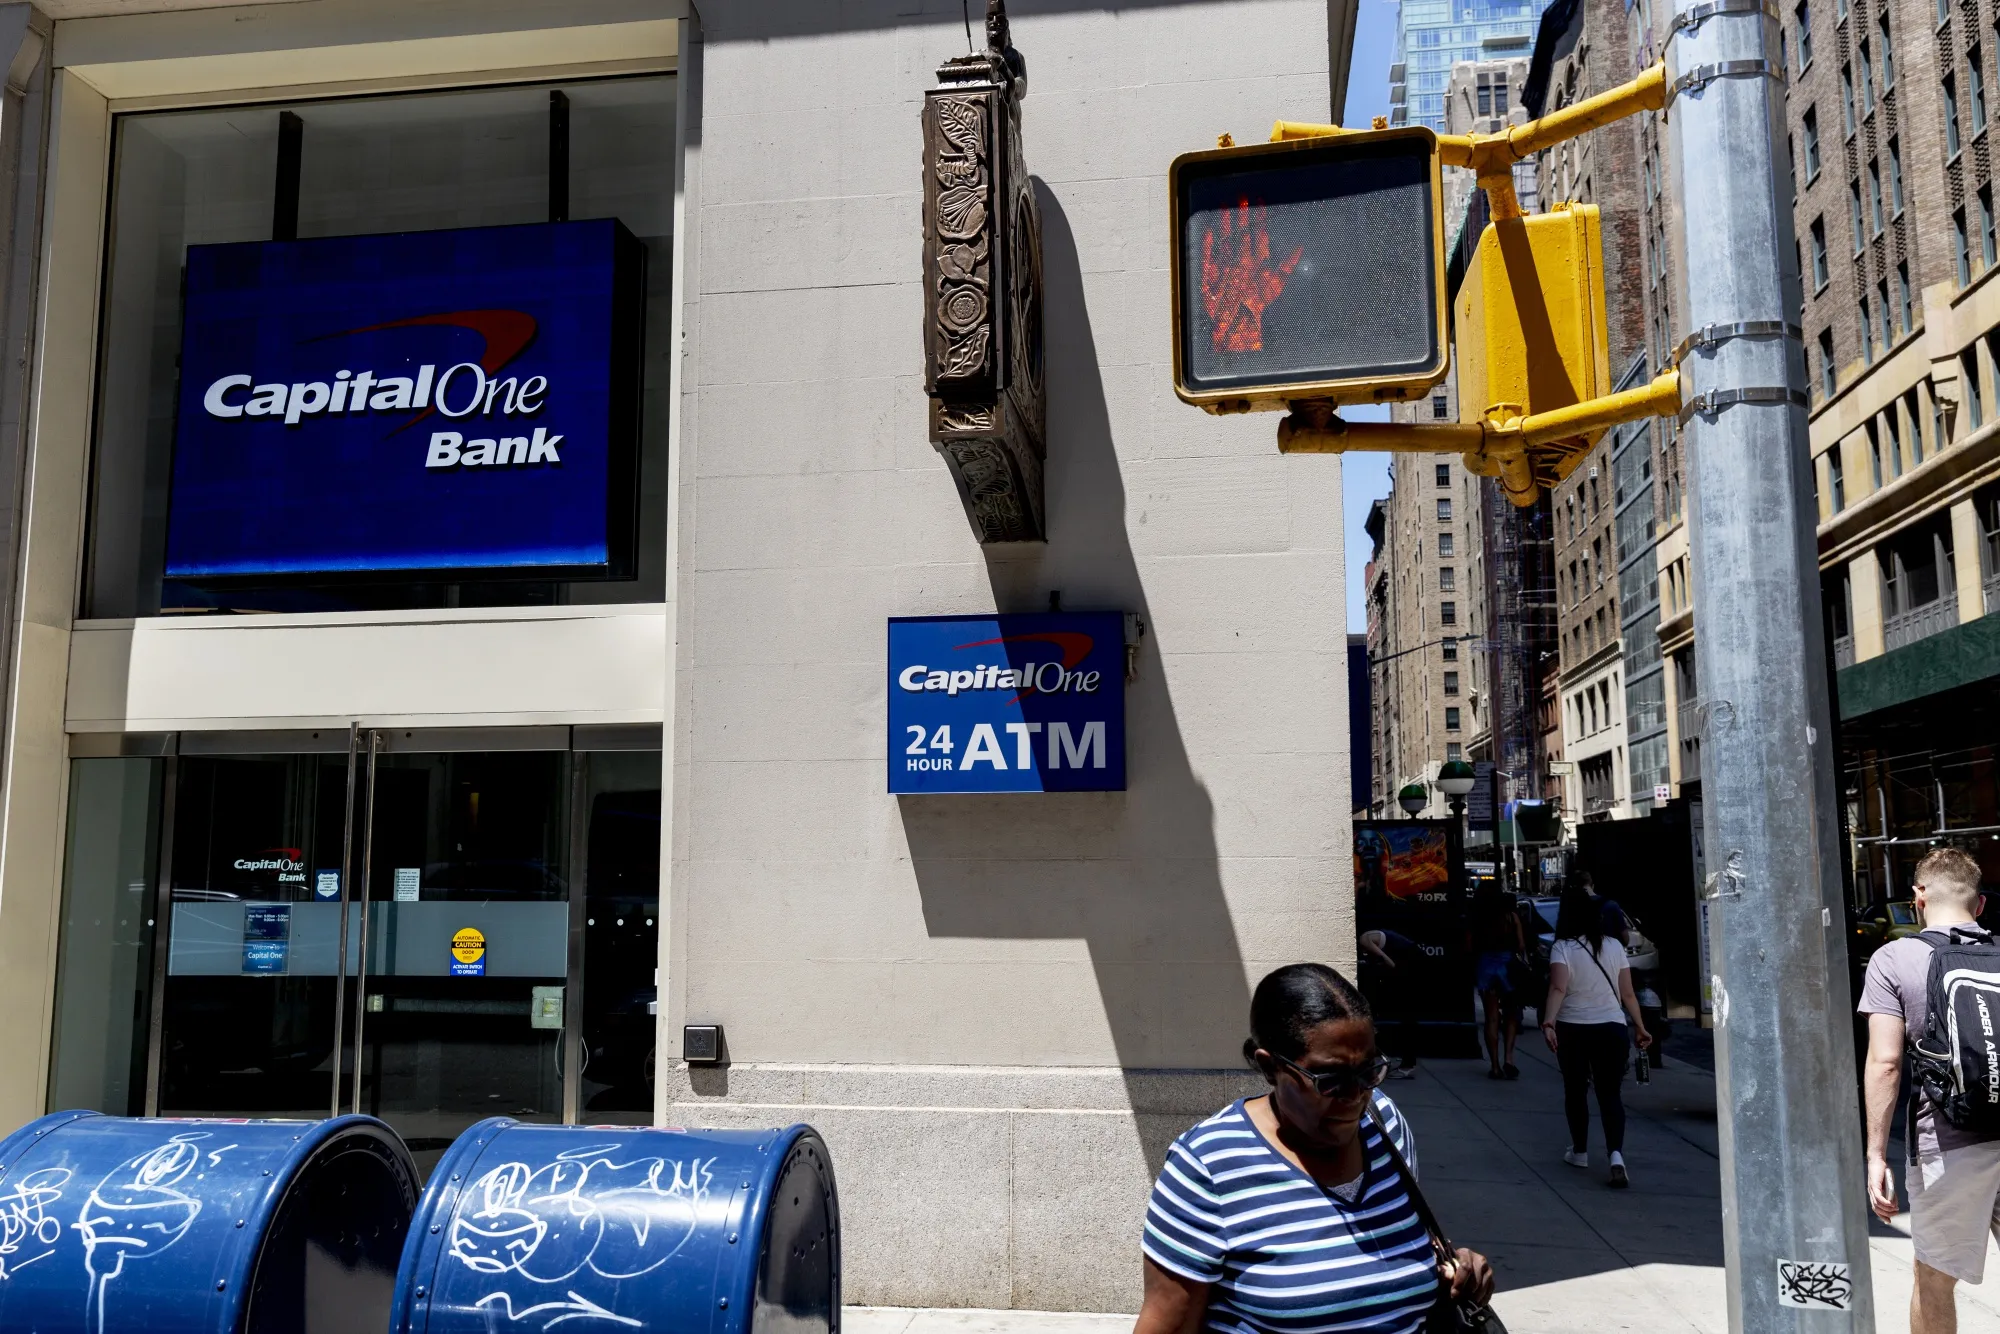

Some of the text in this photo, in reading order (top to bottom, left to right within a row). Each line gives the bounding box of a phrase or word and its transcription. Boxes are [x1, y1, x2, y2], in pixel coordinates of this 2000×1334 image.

[425, 427, 564, 468] Bank
[905, 724, 954, 755] 24
[959, 721, 1106, 771] ATM
[907, 759, 953, 771] HOUR
[278, 873, 306, 882] Bank
[1433, 892, 1448, 902] FX
[248, 952, 269, 960] Capital
[1976, 993, 2000, 1104] UNDER ARMOUR
